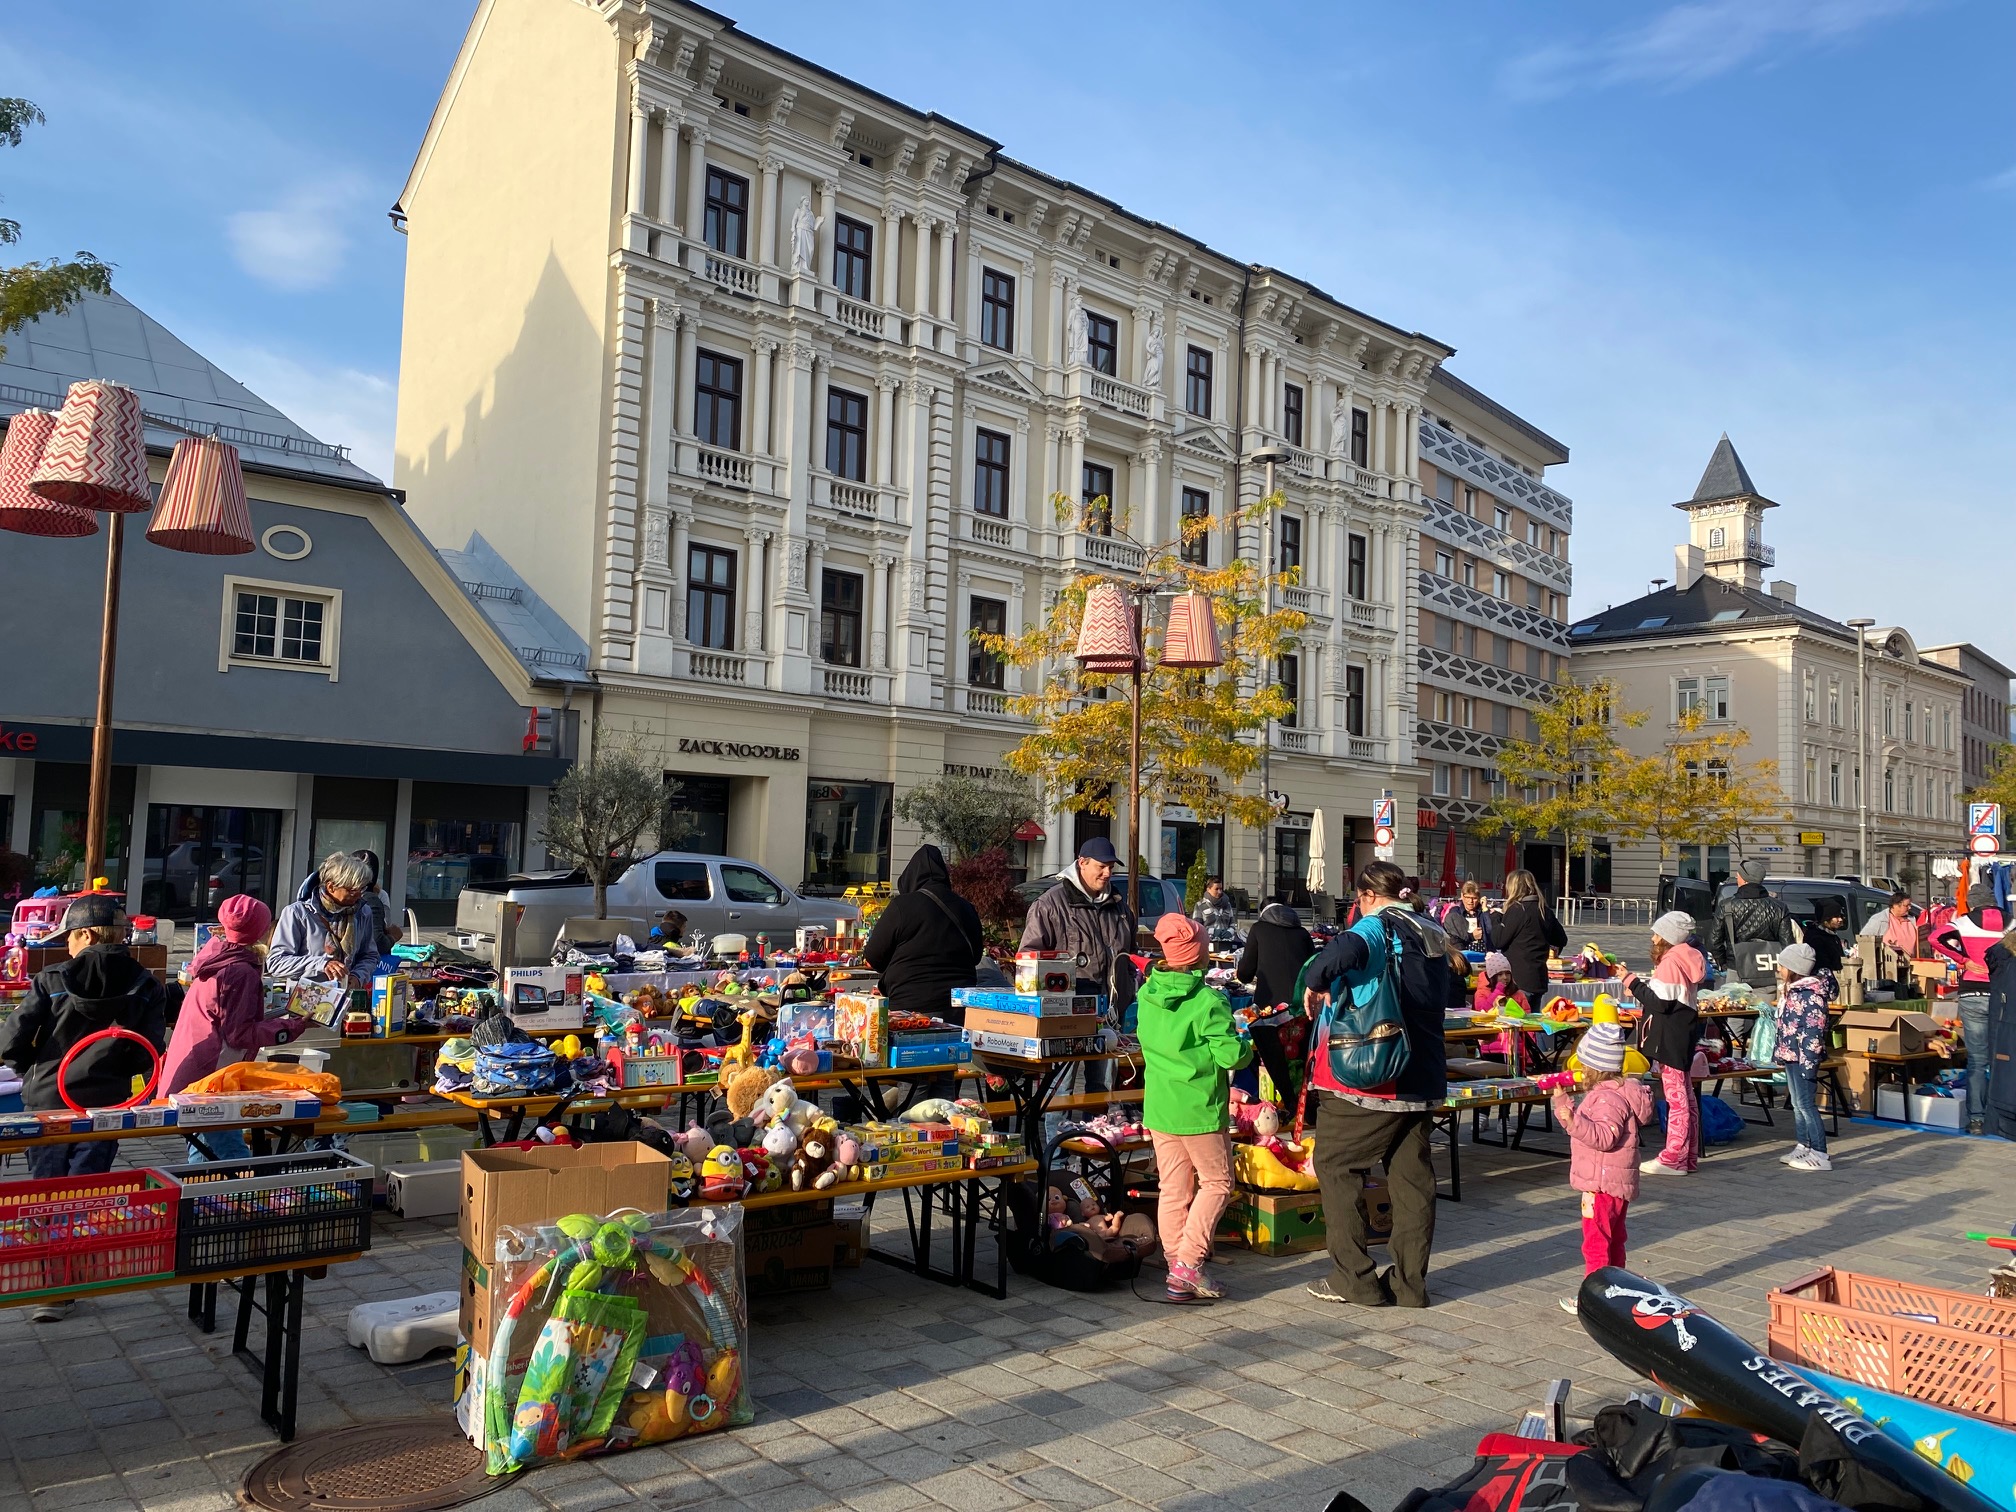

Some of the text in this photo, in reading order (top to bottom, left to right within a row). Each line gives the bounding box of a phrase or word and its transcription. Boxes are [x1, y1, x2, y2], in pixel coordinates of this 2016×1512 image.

[678, 738, 800, 761] ZACK NOODLES
[511, 969, 543, 977] PHILIPS
[987, 1036, 1019, 1048] RoboMaker
[29, 1199, 115, 1215] INTERSPAR
[1742, 1356, 1873, 1445] PIRATES
